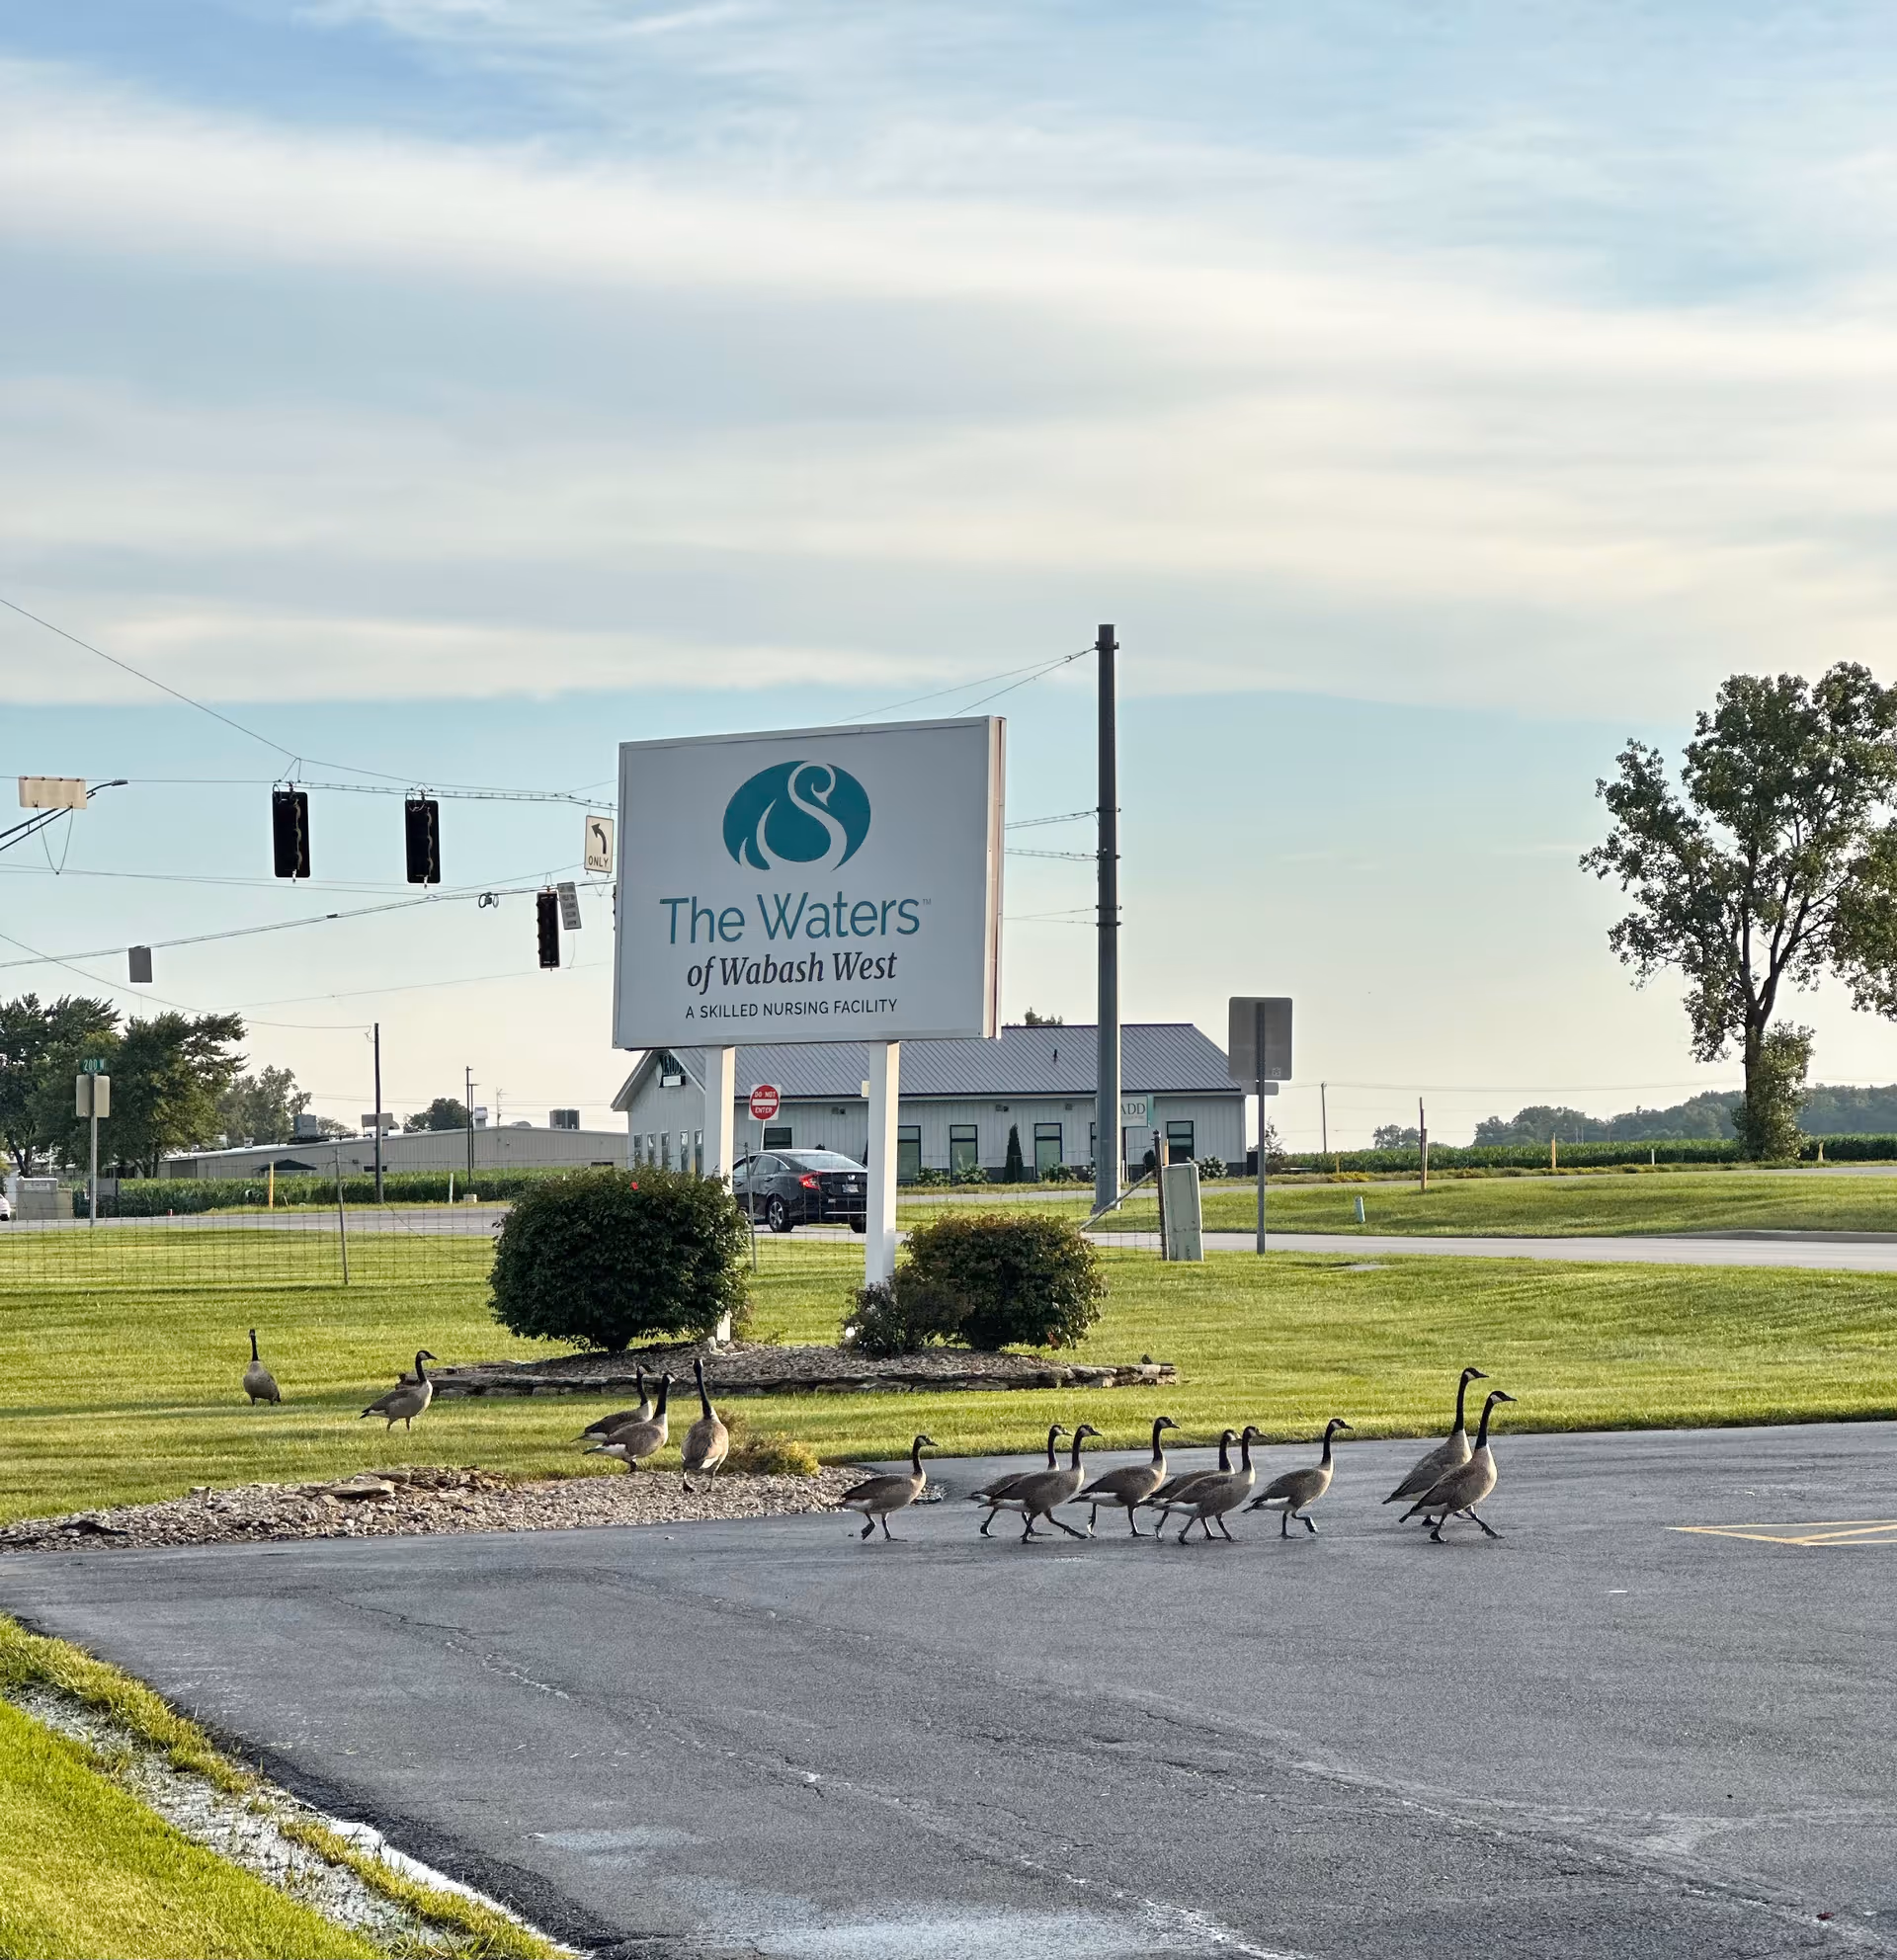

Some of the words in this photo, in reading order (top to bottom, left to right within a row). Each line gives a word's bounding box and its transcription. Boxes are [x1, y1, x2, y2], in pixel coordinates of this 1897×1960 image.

[588, 856, 609, 867] ONLY
[659, 896, 746, 944] The
[756, 891, 921, 940] Waters
[687, 955, 716, 996] of
[719, 951, 824, 986] Wabash
[832, 951, 898, 981] West
[685, 1006, 695, 1020] A
[700, 1004, 759, 1019] SKILLED
[763, 1001, 829, 1017] NURSING
[834, 999, 898, 1015] FACILITY
[83, 1058, 98, 1071] 200
